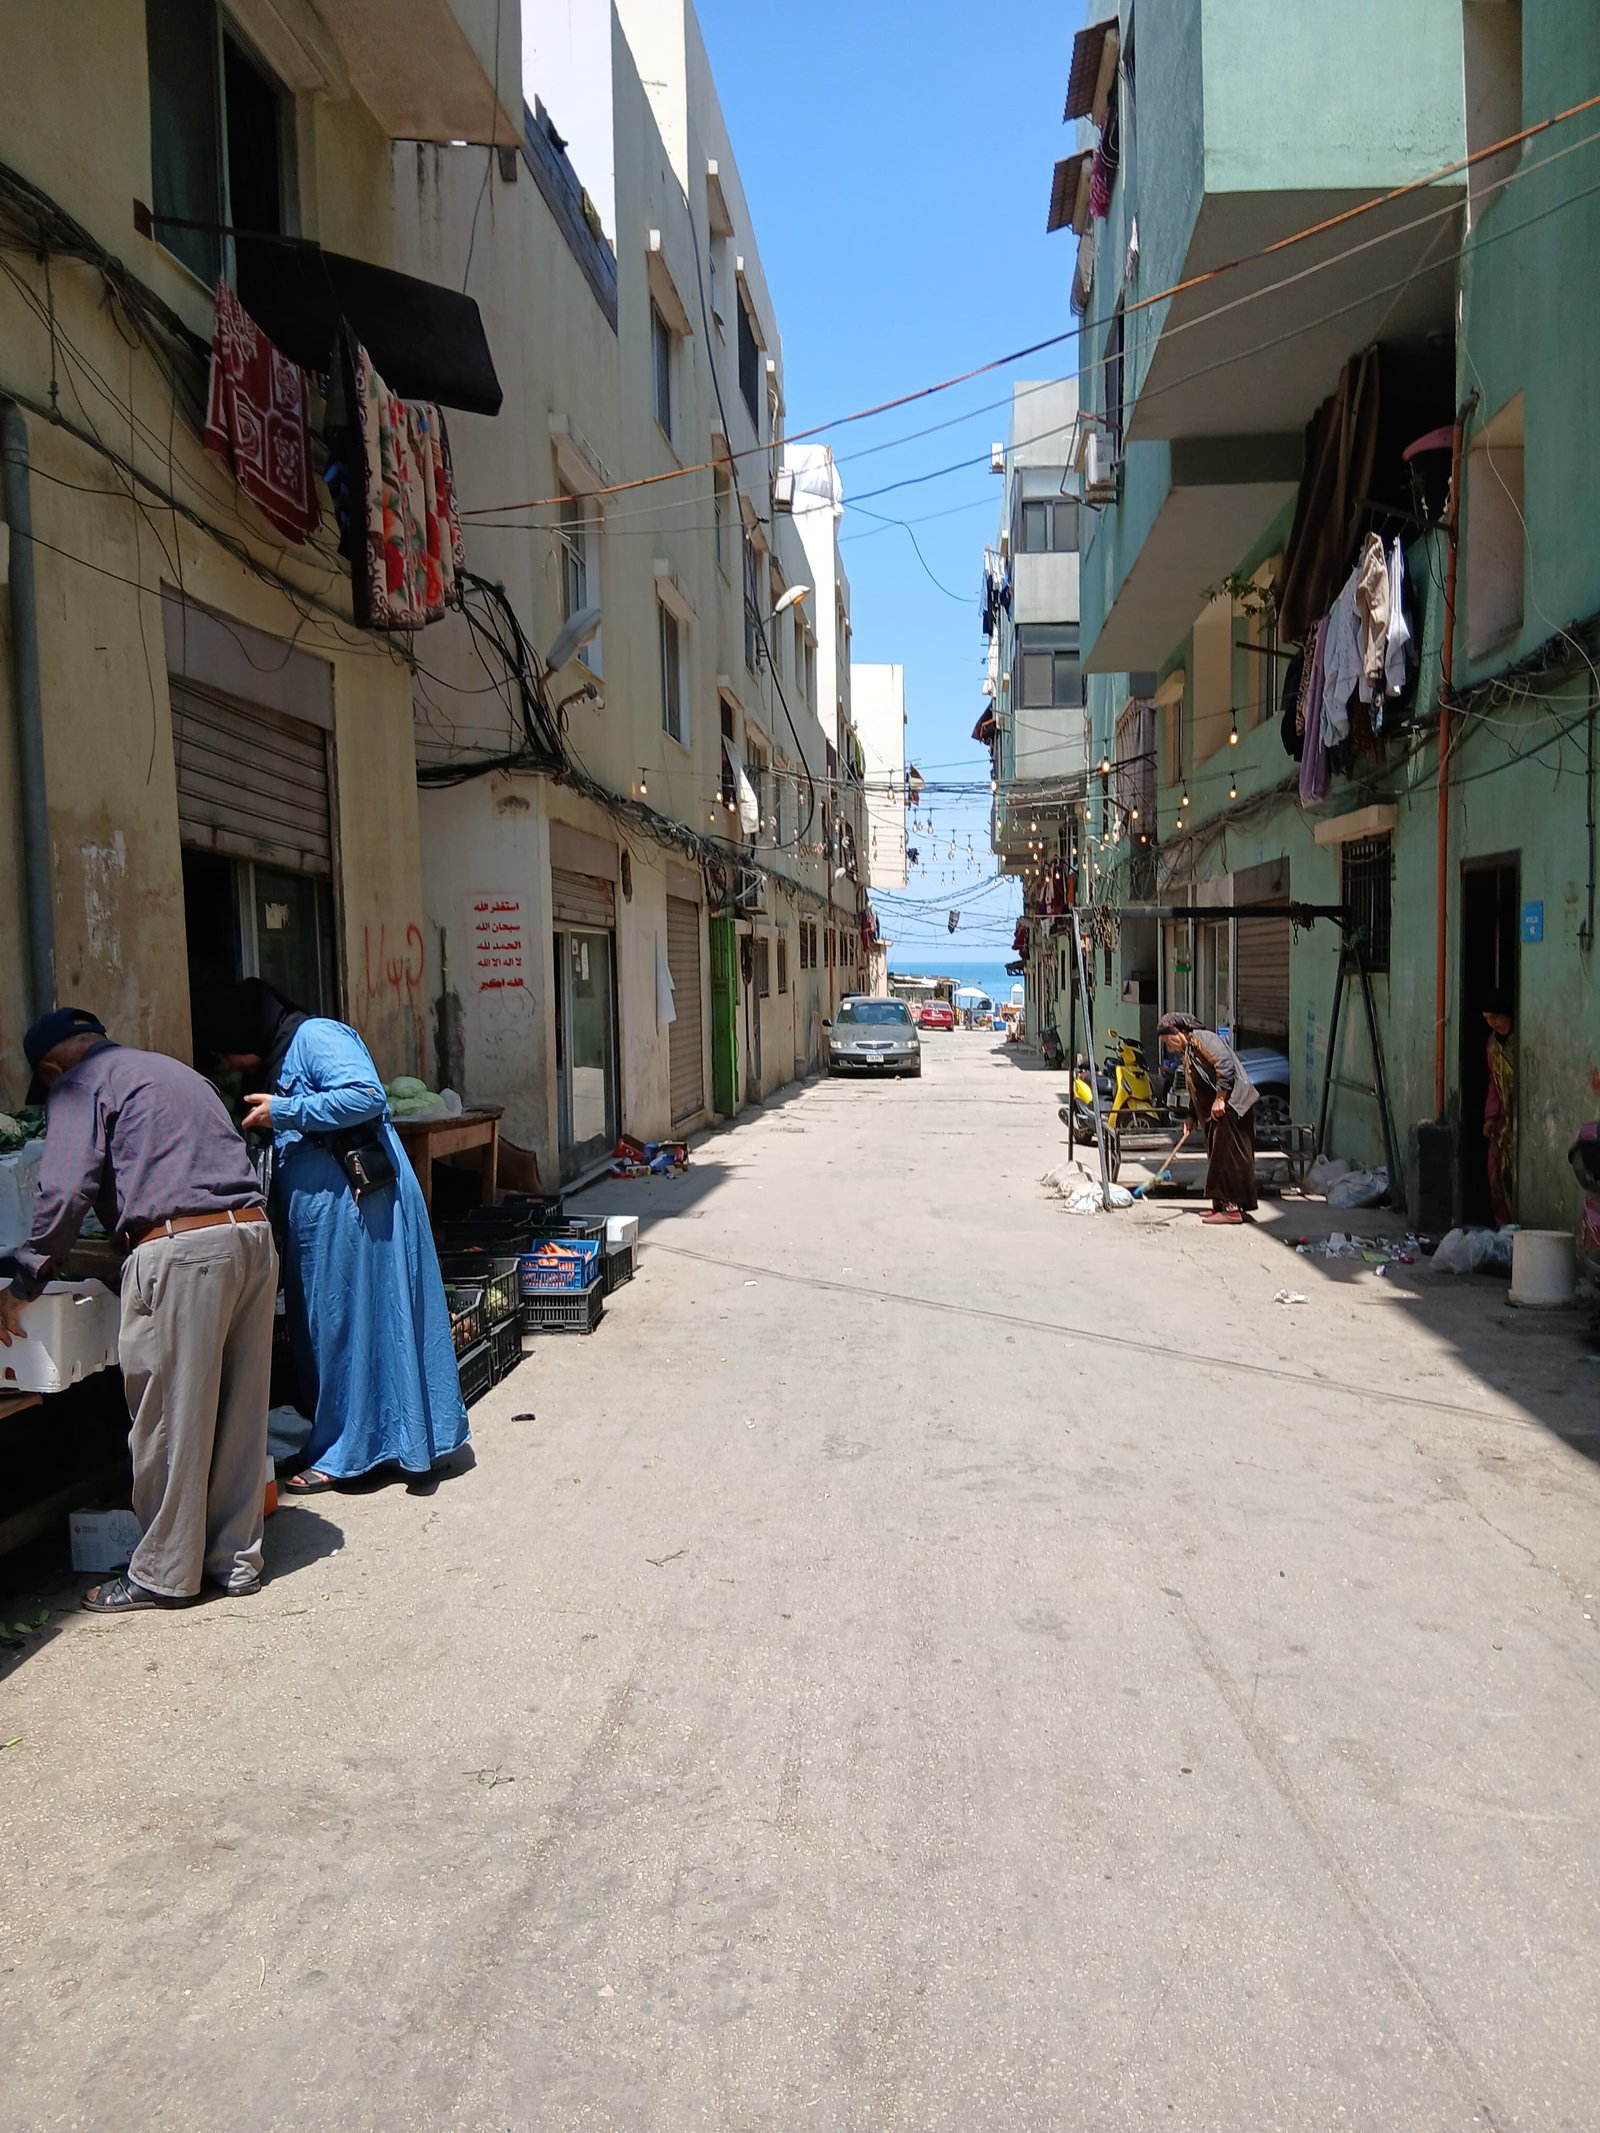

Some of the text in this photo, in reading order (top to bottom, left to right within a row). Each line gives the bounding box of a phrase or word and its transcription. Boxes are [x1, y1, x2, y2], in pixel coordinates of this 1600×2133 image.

[474, 902, 488, 911] الله
[475, 922, 520, 933] سبحان الله
[477, 940, 521, 950] الحمد لله
[477, 958, 491, 967] الله
[515, 957, 521, 966] لا
[507, 978, 524, 987] الله
